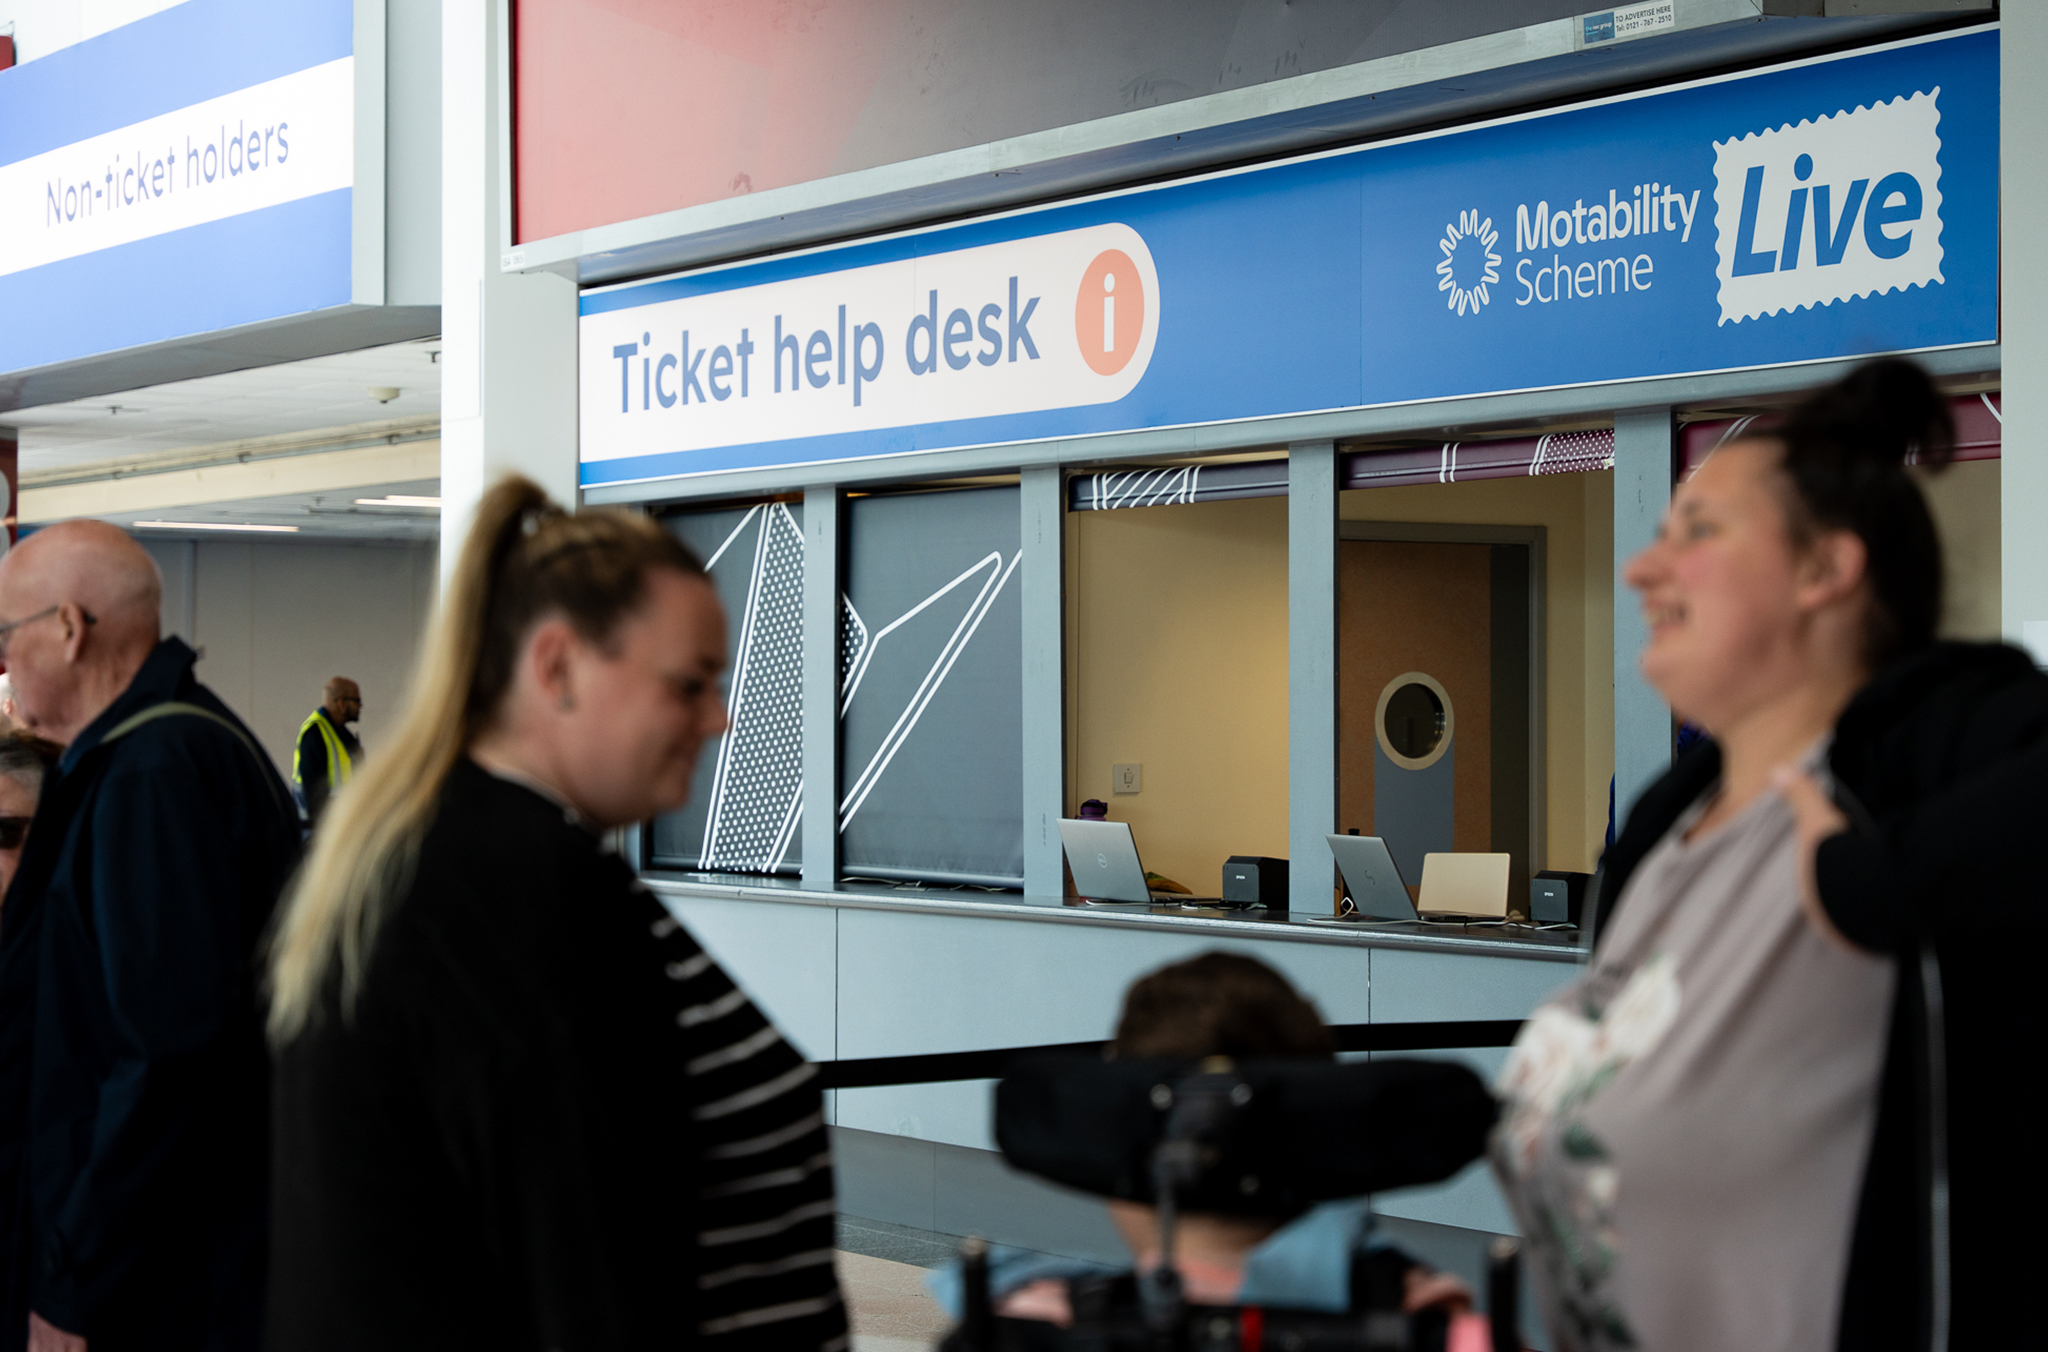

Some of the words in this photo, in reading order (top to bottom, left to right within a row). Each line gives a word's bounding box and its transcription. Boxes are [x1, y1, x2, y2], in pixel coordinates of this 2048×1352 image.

[1615, 15, 1624, 23] TO
[1624, 9, 1655, 21] ADVERTISE
[1656, 5, 1671, 14] HERE
[1616, 24, 1625, 32] Tel:
[1626, 21, 1639, 30] 0121
[1643, 18, 1654, 26] 767
[1658, 15, 1672, 24] 2510
[46, 145, 176, 228] Non-ticket
[186, 118, 290, 189] holders
[1515, 182, 1701, 254] Motability
[1730, 152, 1925, 279] Live
[1515, 252, 1654, 306] Scheme
[612, 327, 755, 414] Ticket
[774, 303, 885, 408] help
[905, 275, 1042, 376] desk
